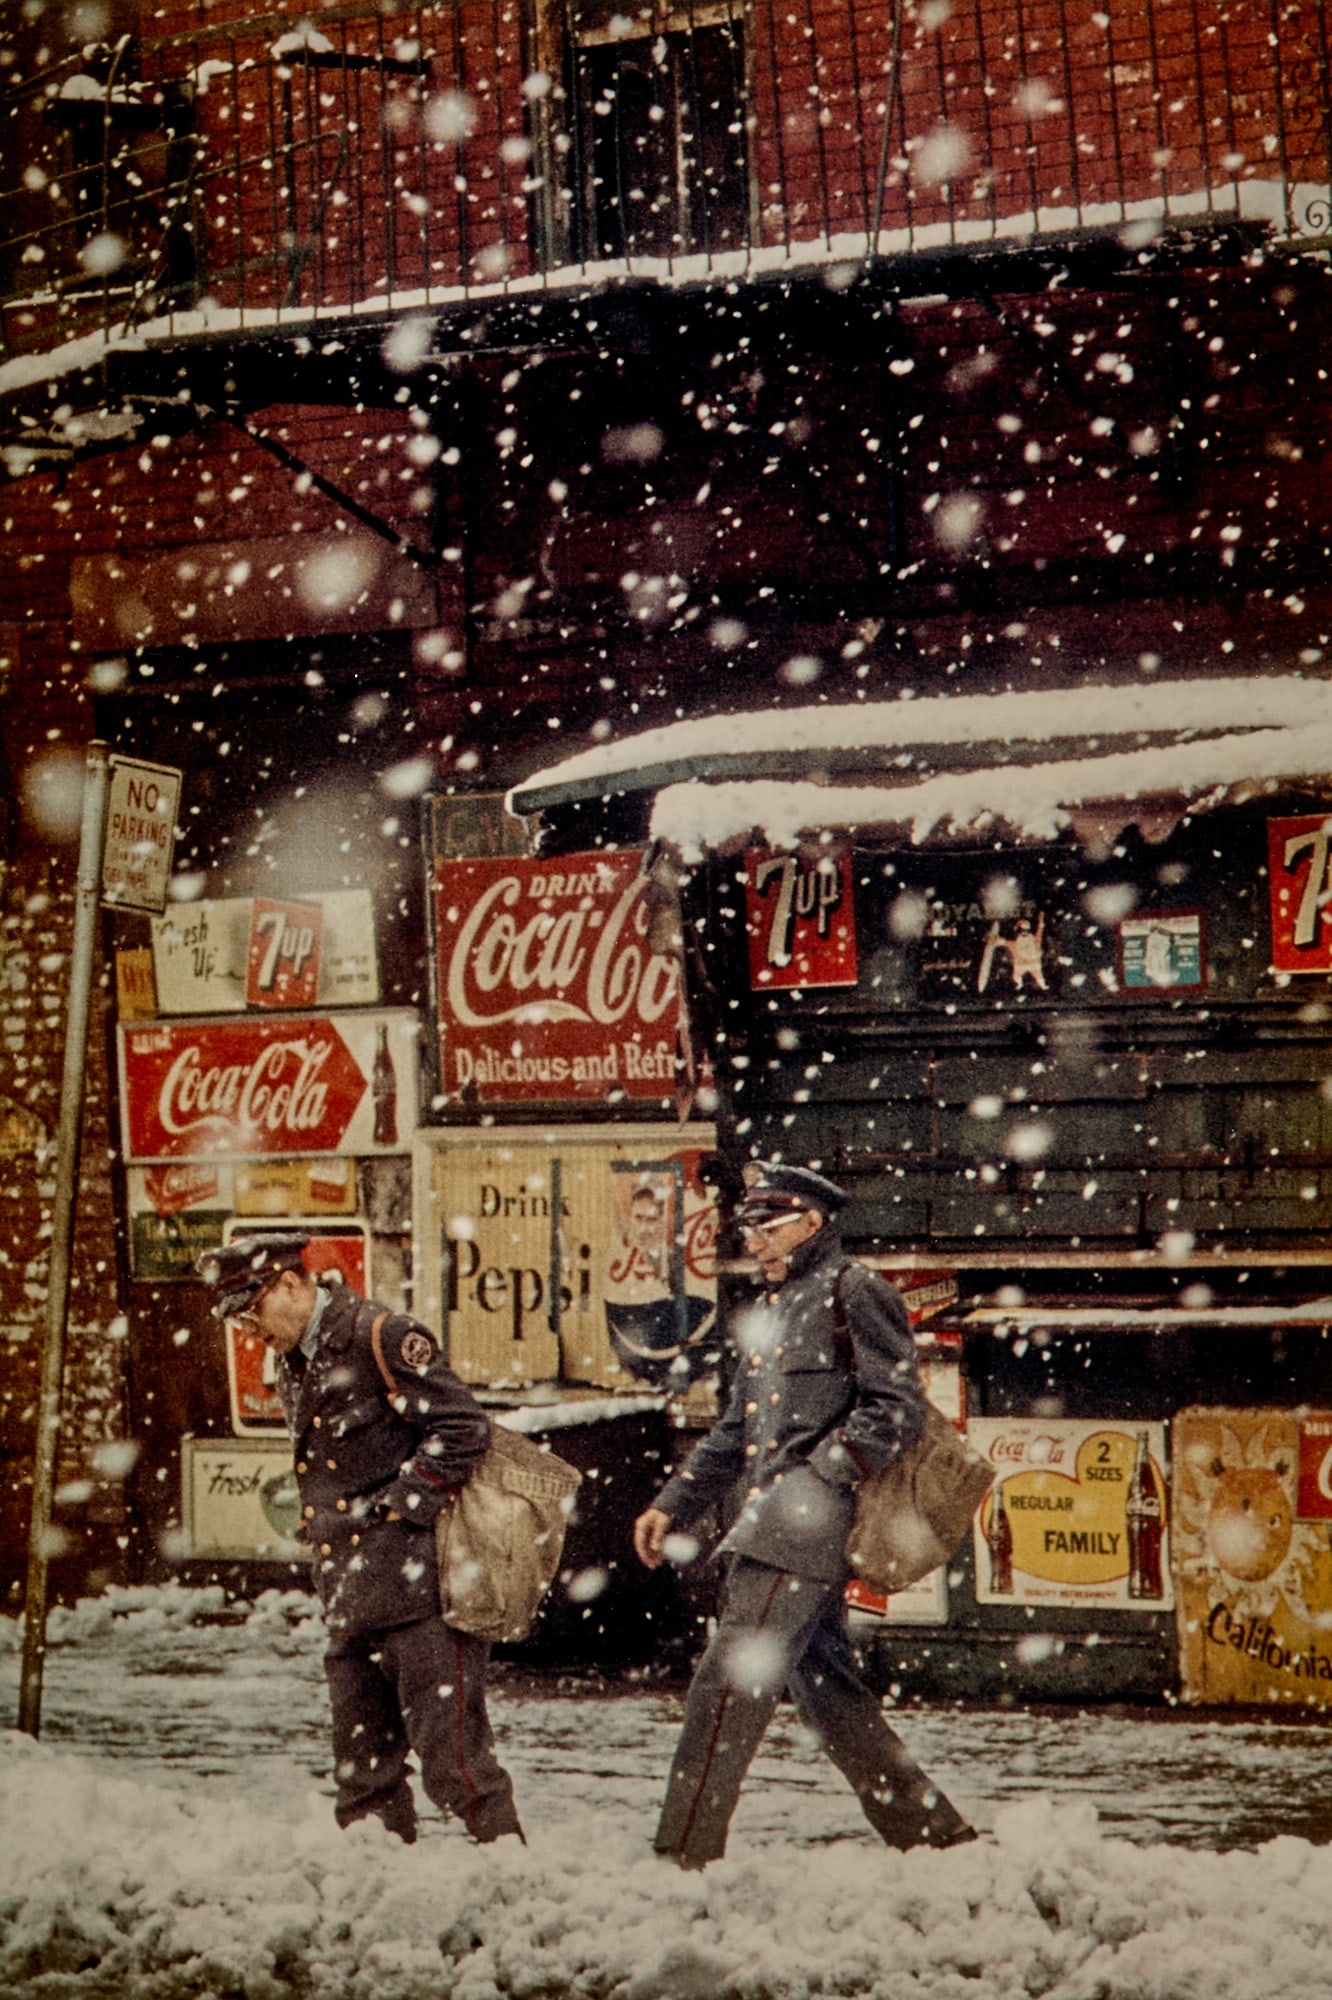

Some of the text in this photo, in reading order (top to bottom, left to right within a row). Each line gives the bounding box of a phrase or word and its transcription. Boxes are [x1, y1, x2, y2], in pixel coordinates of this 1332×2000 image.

[127, 778, 160, 813] NO
[111, 812, 167, 849] PARKING
[527, 870, 620, 898] DRINK
[455, 1046, 568, 1084] Delicious
[571, 1043, 619, 1082] and
[158, 1038, 334, 1136] Coca-Cola
[1097, 1442, 1110, 1463] 2
[1085, 1467, 1123, 1482] SIZES
[1010, 1495, 1074, 1512] REGULAR
[1043, 1530, 1121, 1555] FAMILY
